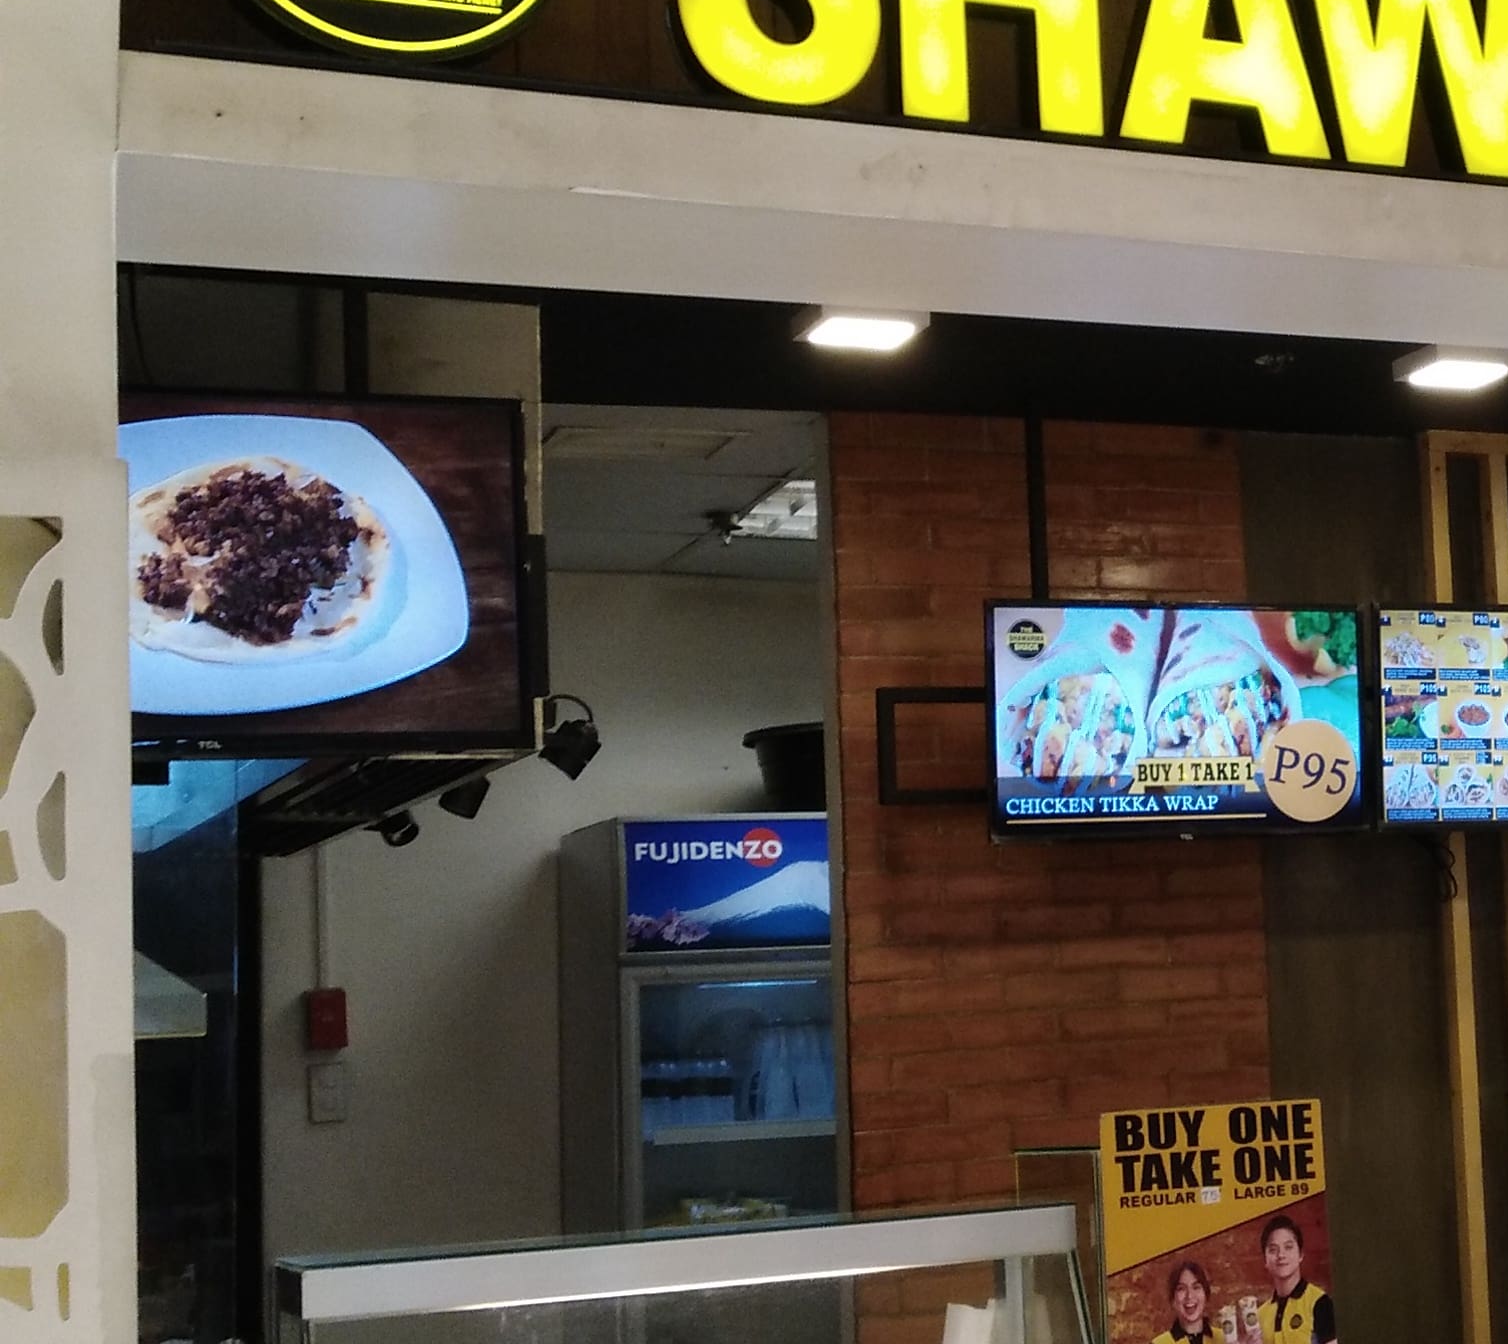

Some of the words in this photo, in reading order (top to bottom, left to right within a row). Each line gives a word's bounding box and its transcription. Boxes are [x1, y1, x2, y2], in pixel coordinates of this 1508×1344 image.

[1138, 763, 1172, 782] BUY
[1177, 763, 1185, 781] 1
[1191, 762, 1240, 781] TAKE
[1246, 762, 1254, 780] 1
[1269, 745, 1350, 795] P95
[1006, 797, 1095, 815] CHICKEN
[1099, 796, 1160, 813] TIKKA
[1164, 794, 1219, 812] WRAP
[634, 839, 783, 864] FUJIDENZO
[1114, 1110, 1205, 1152] BUY
[1229, 1104, 1314, 1144] ONE
[1115, 1150, 1223, 1193] TAKE
[1233, 1143, 1315, 1184] ONE
[1120, 1192, 1196, 1209] REGULAR
[1234, 1185, 1286, 1200] LARGE
[1291, 1183, 1309, 1196] 89
